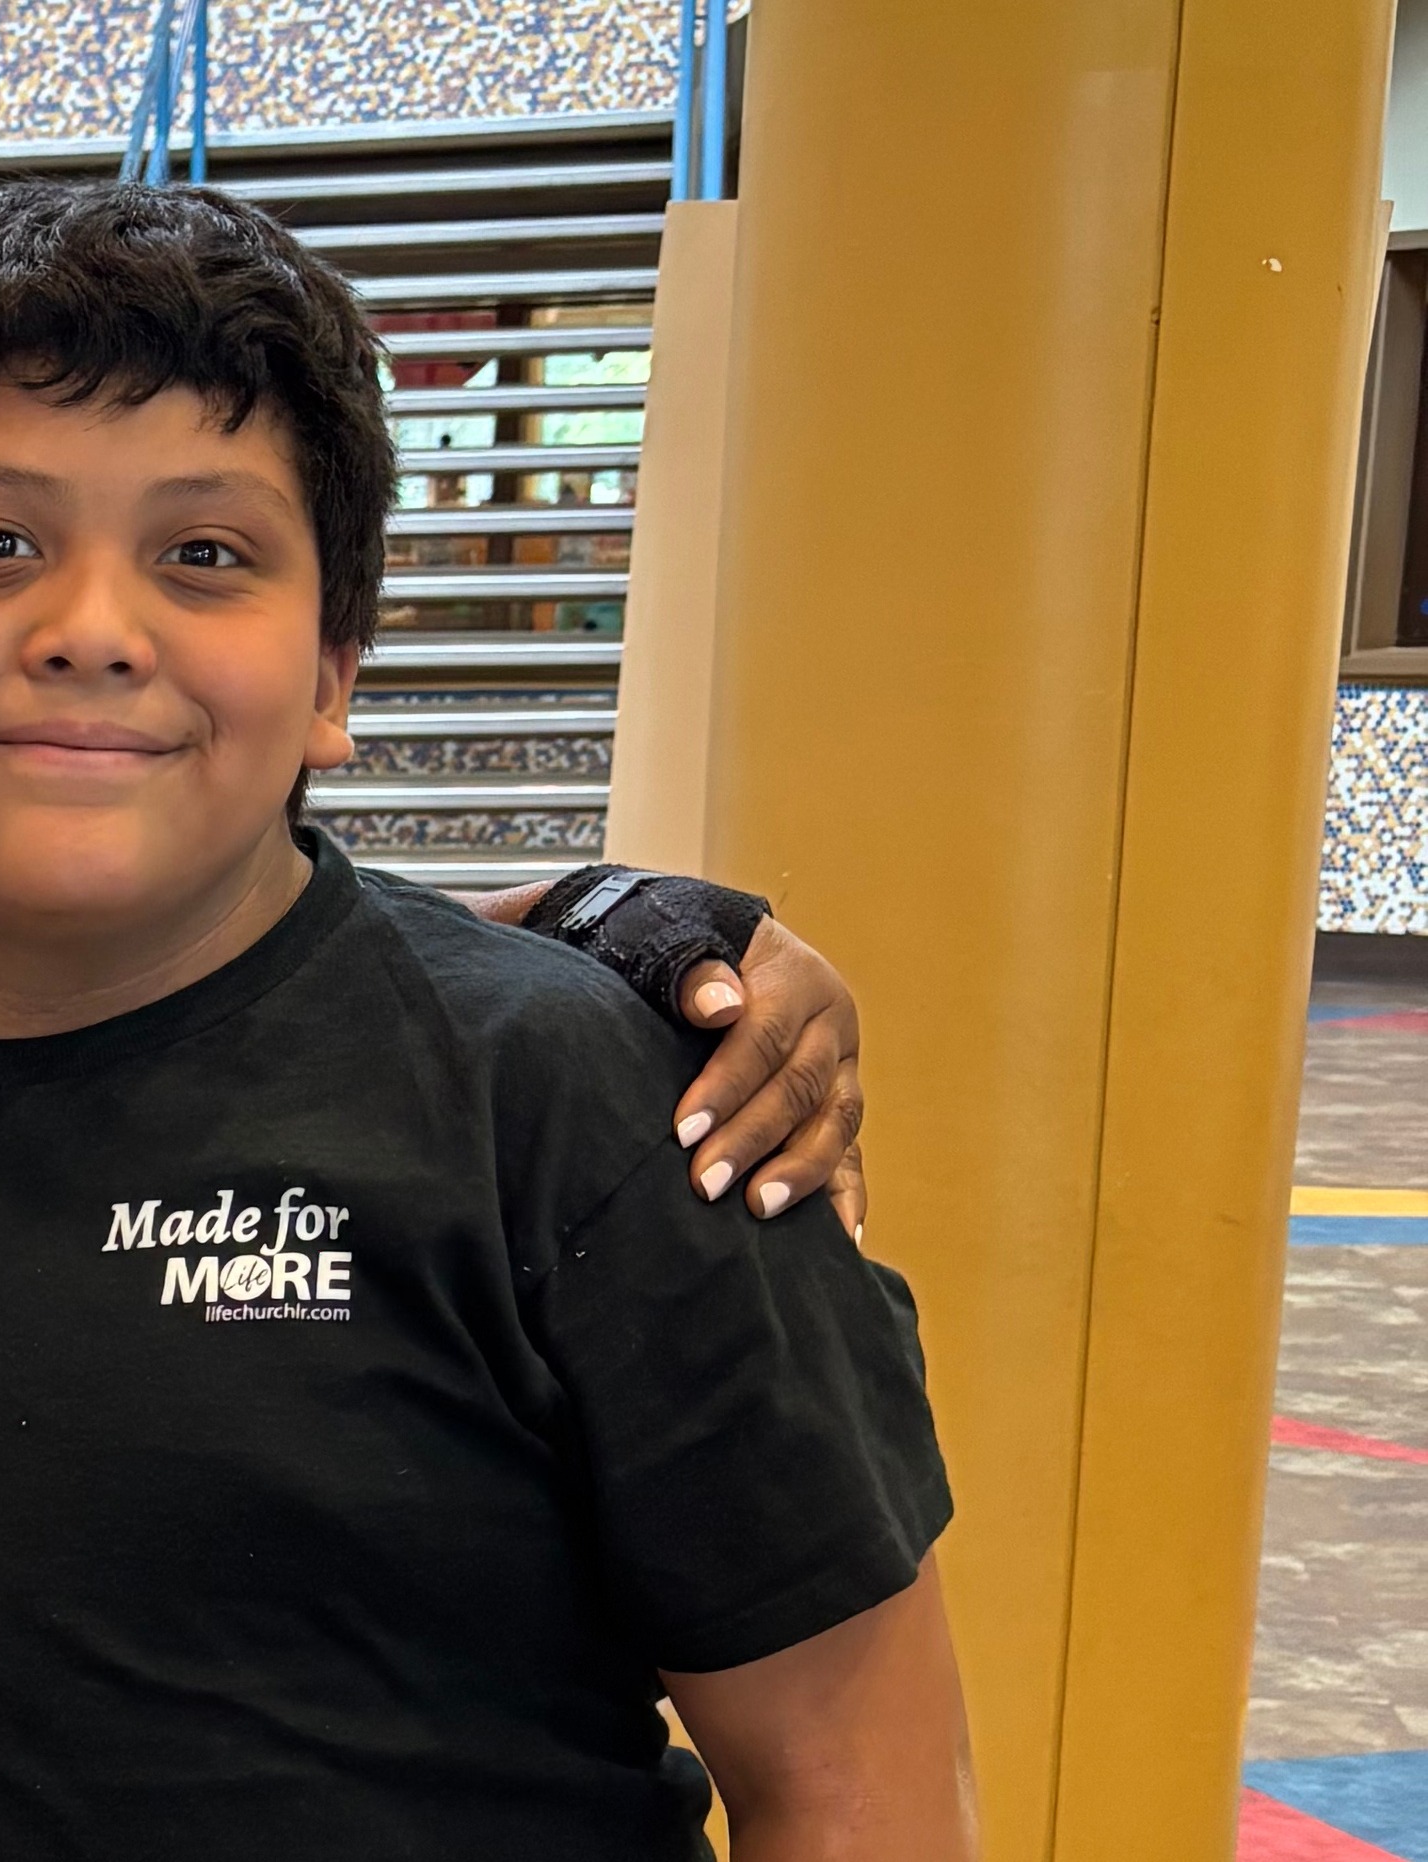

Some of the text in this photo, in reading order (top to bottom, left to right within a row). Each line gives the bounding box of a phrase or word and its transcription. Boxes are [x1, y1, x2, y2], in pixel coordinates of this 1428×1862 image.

[101, 1187, 350, 1256] Made for
[160, 1251, 352, 1305] MORE
[205, 1302, 351, 1323] lifechurchlr.com
